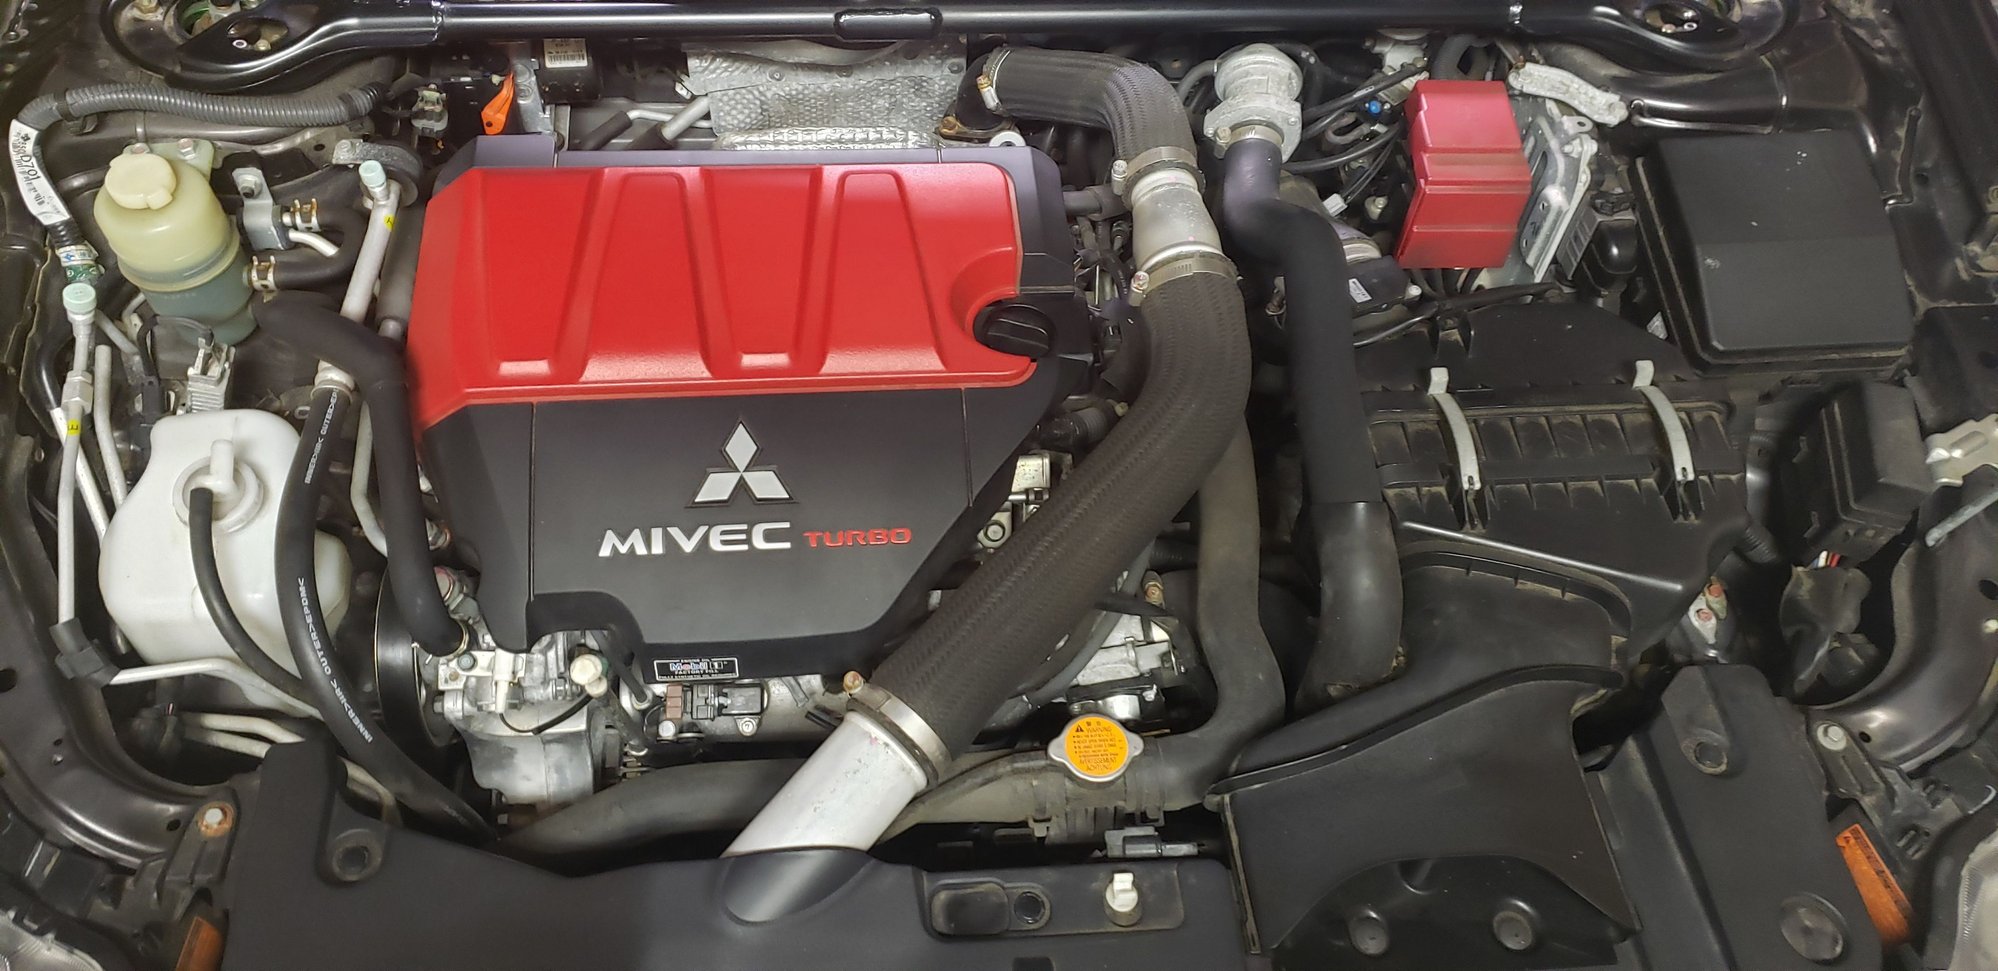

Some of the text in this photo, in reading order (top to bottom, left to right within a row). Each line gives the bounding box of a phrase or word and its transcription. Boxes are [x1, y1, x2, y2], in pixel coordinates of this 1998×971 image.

[20, 154, 41, 181] D701
[598, 521, 912, 557] MIVEC TURBO
[669, 661, 708, 671] Mobil
